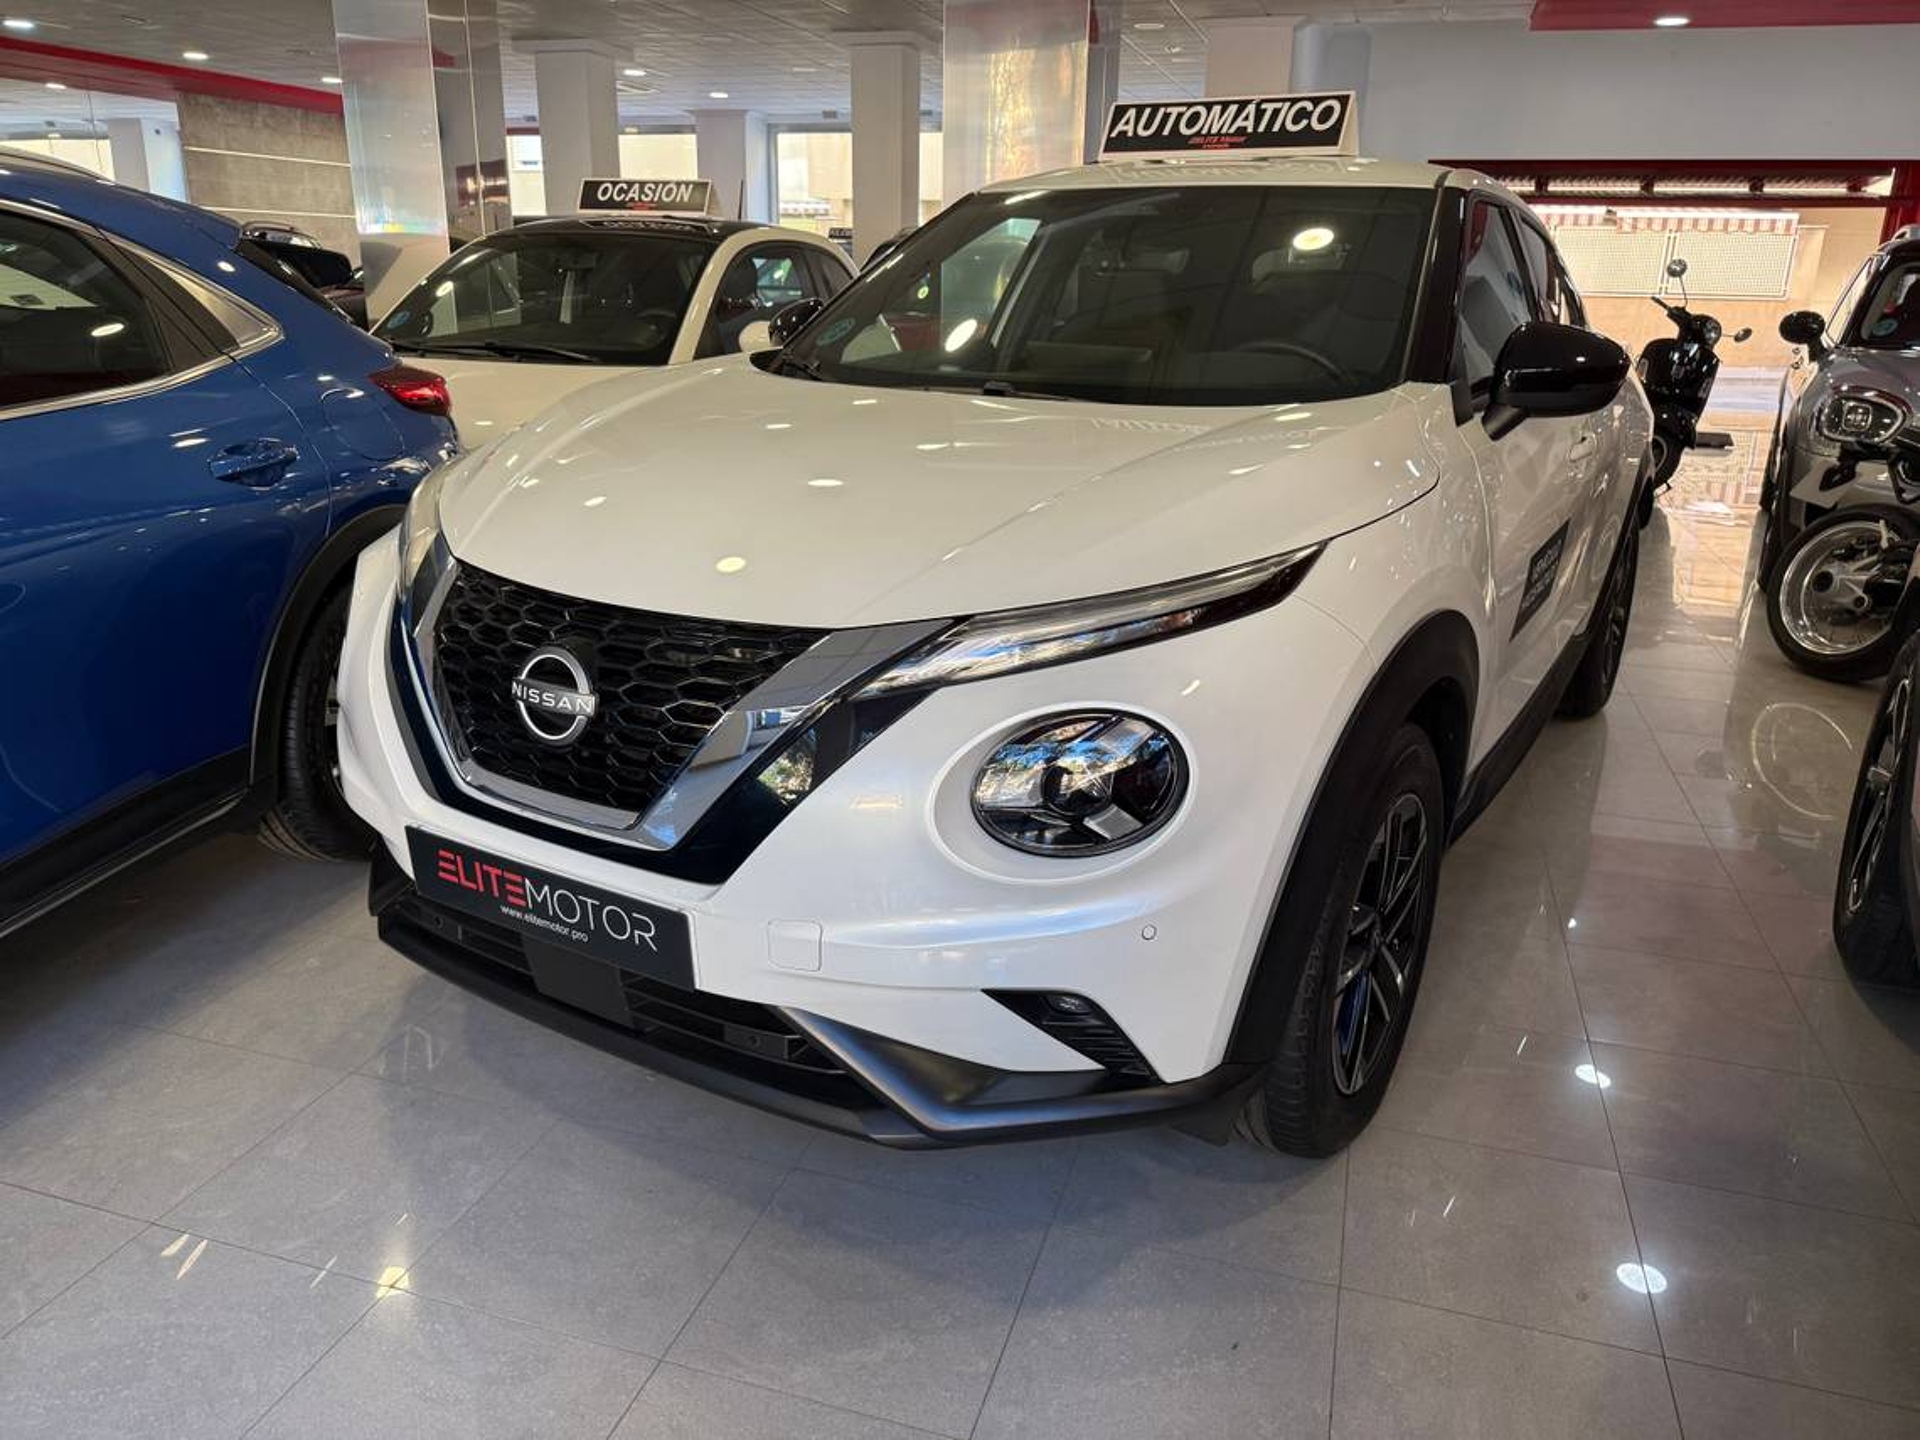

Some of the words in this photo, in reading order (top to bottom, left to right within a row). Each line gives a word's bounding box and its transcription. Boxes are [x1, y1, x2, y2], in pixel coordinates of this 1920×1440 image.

[1110, 99, 1341, 138] AUTOMÁTICO
[512, 681, 592, 713] NISSAN
[437, 849, 658, 952] ELITEMOTOR
